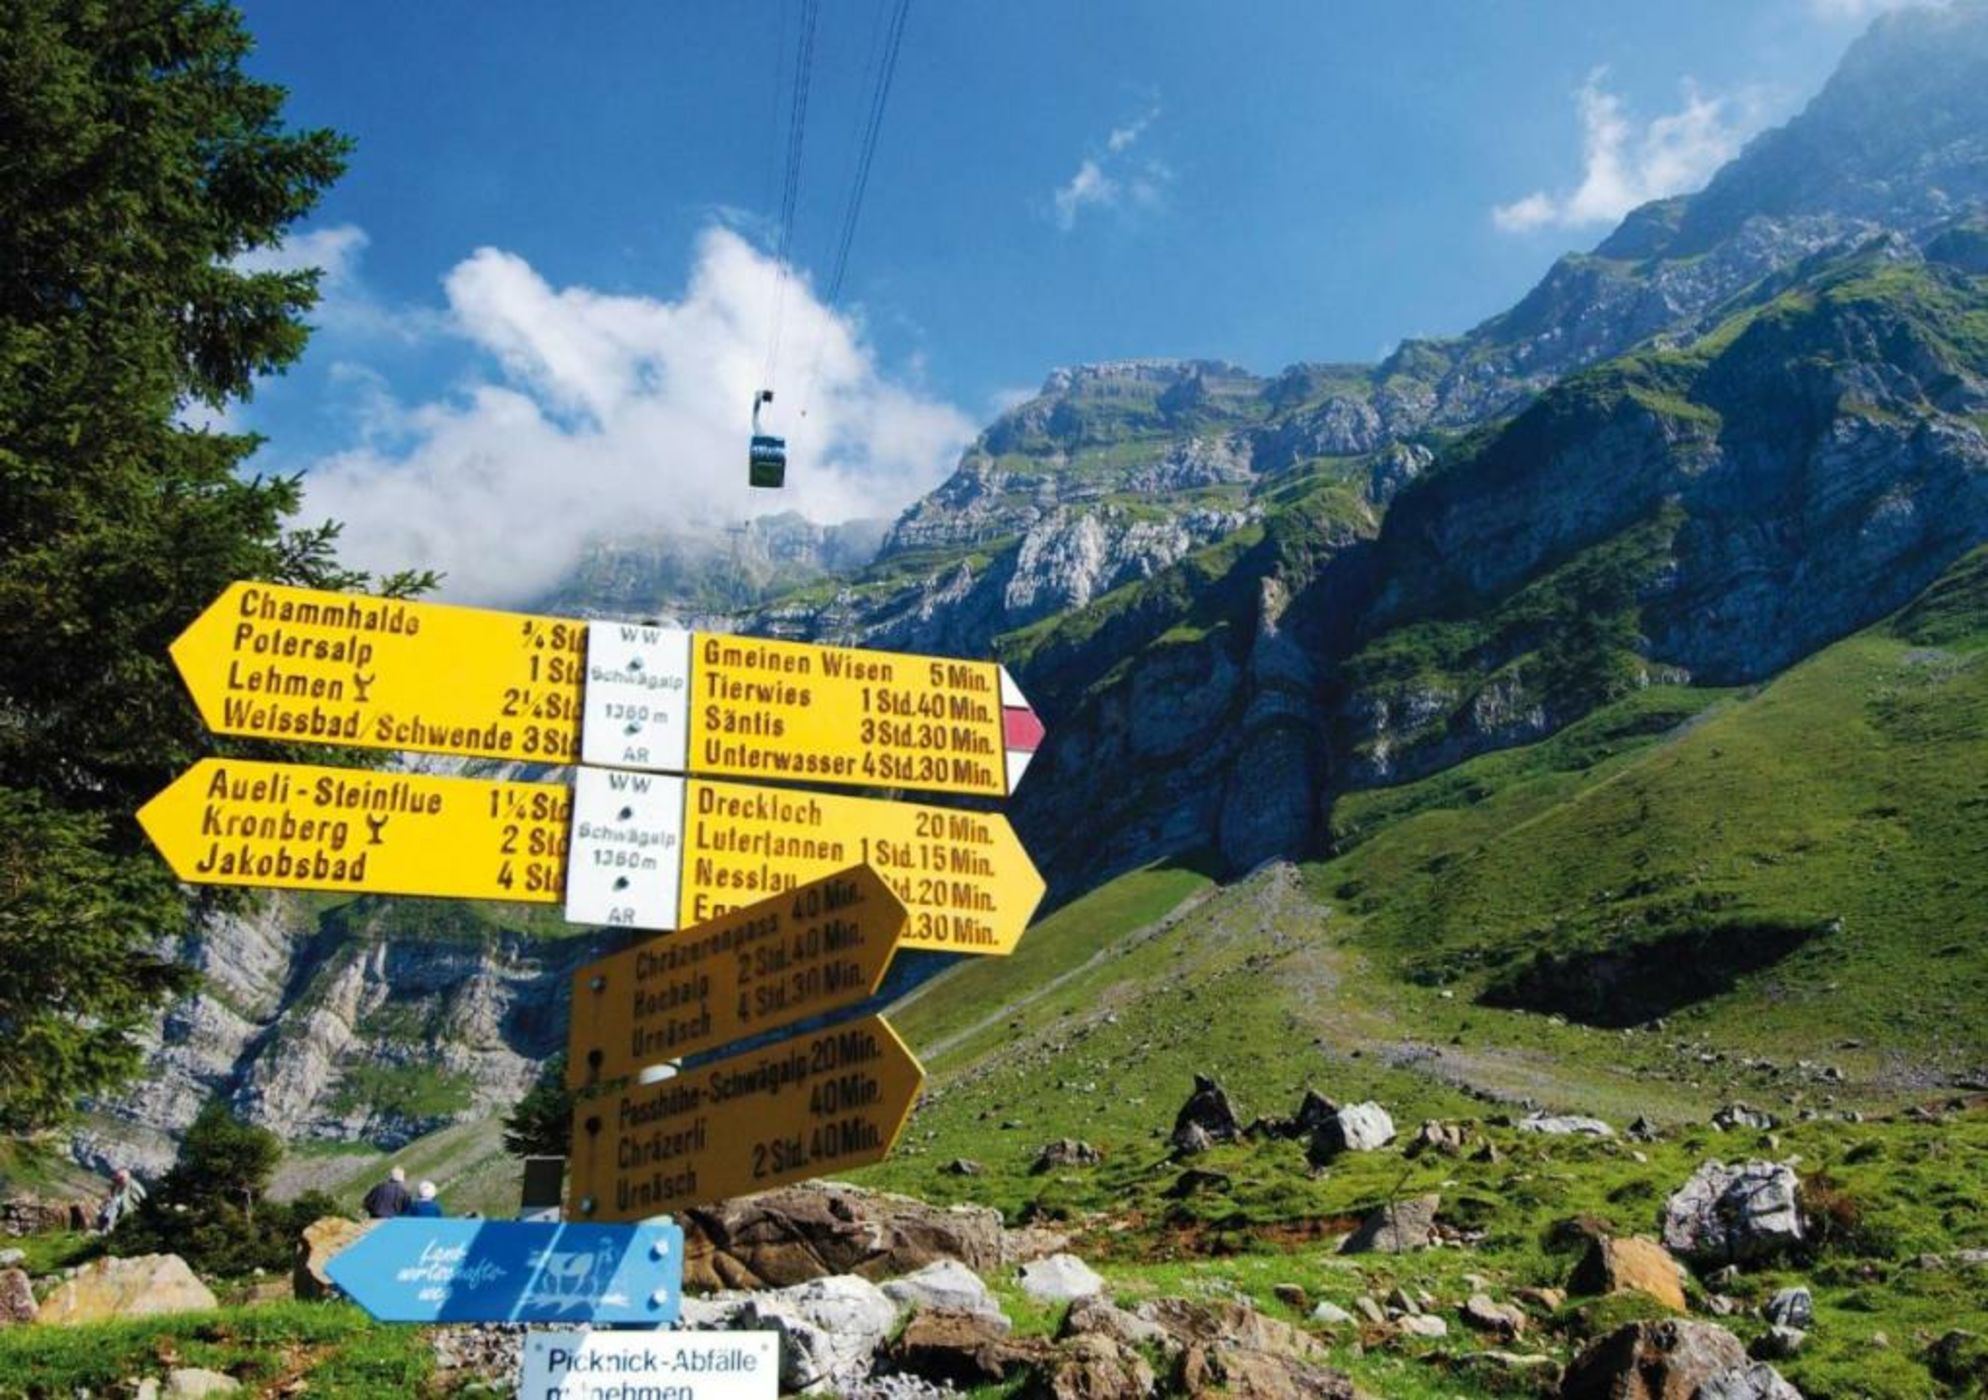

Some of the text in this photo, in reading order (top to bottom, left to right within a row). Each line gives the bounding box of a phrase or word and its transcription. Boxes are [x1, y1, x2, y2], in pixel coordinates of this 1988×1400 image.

[240, 589, 420, 636] Chammhalde
[233, 622, 373, 669] Potersalp
[530, 655, 539, 682] 1
[705, 639, 991, 692] Gmeinen Wisen 5 Min.
[228, 660, 343, 701] Lehmen
[591, 666, 685, 691] Schwägalp
[706, 672, 811, 707] Tierwies
[951, 696, 994, 724] Min.
[522, 726, 539, 753] 3
[705, 704, 785, 738] Säntis
[952, 727, 995, 755] Min.
[623, 747, 650, 763] AR
[705, 738, 856, 776] Unterwasser
[953, 758, 998, 788] Min.
[202, 804, 348, 851] Kronberg
[500, 825, 519, 855] 2
[578, 821, 676, 849] Schwägalp
[698, 787, 994, 845] Dreckloch 20 Min.
[196, 842, 367, 882] Jakobsbad
[497, 860, 513, 890] 4
[697, 820, 844, 862] Lutertannen
[951, 848, 995, 877] Min.
[695, 857, 797, 892] Nesslau
[952, 882, 997, 911] Min.
[608, 907, 636, 924] AR
[953, 915, 1000, 946] Min.
[811, 1036, 835, 1074] 20
[809, 1084, 835, 1119] 40
[752, 1143, 767, 1180] 2
